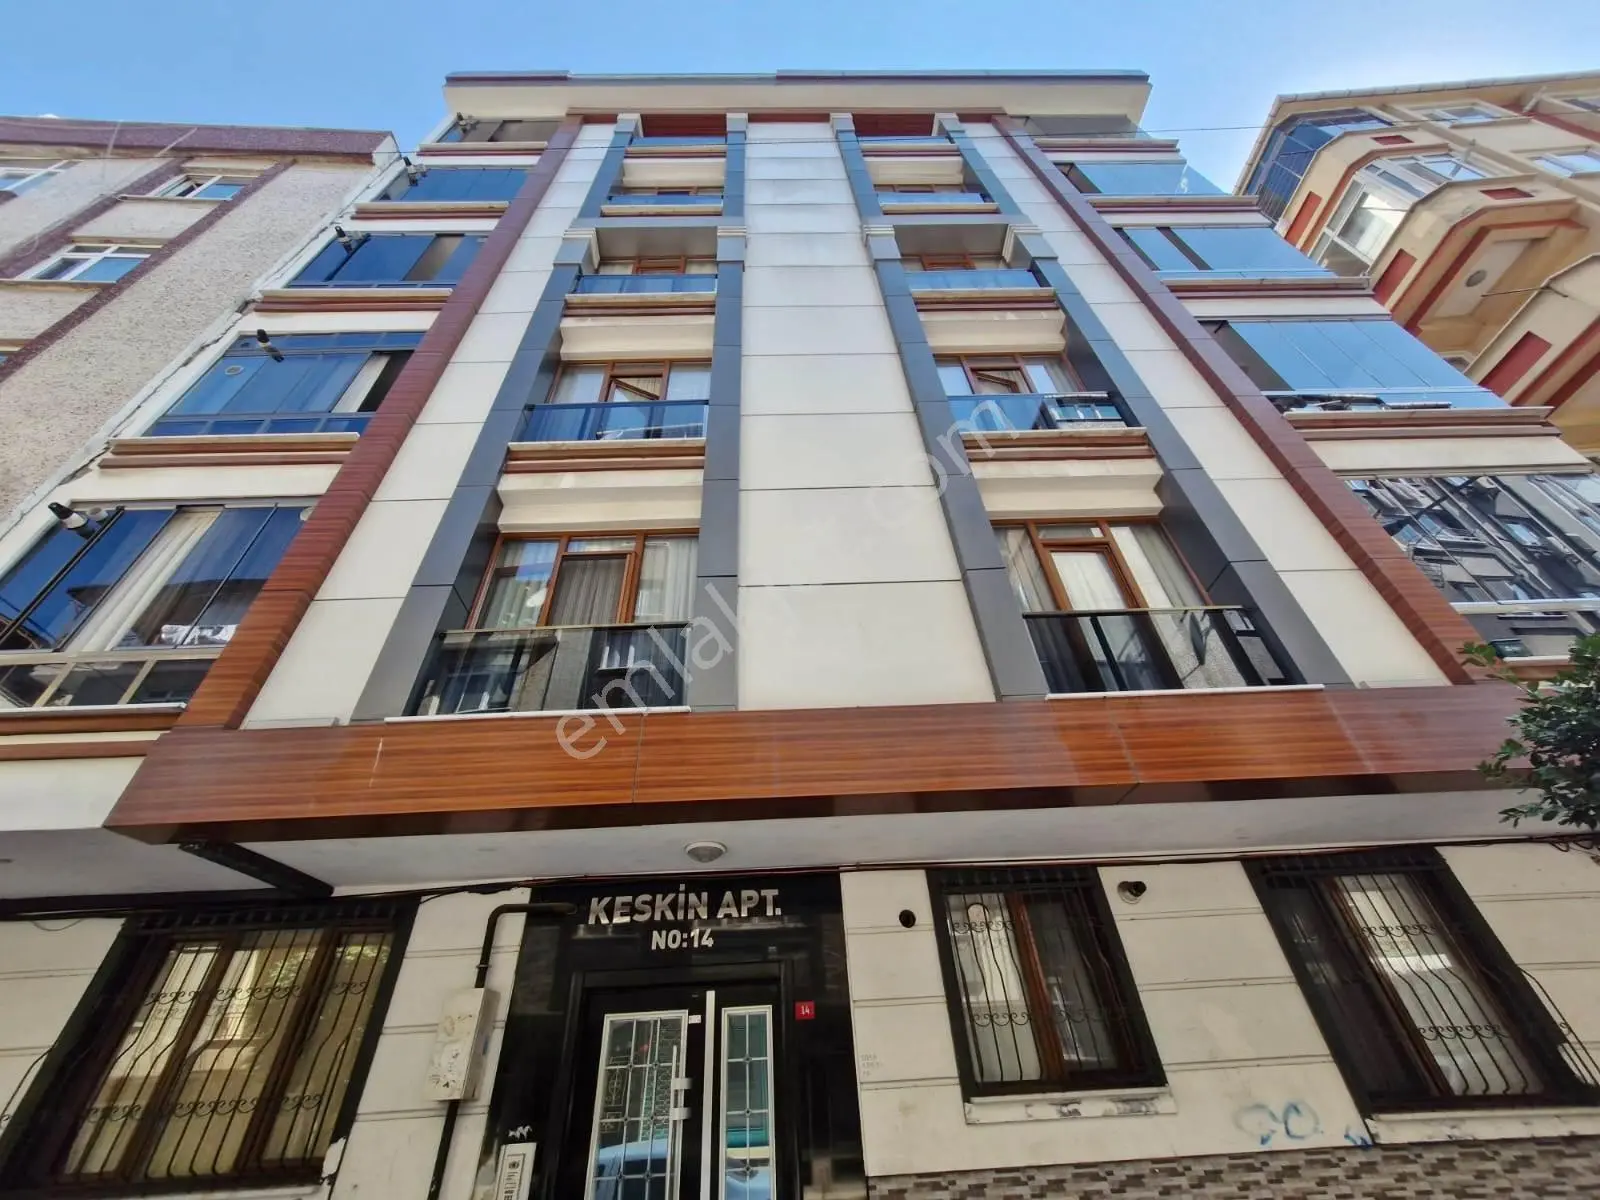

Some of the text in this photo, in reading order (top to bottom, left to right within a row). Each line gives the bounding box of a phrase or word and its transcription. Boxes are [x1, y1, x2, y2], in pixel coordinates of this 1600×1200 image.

[588, 883, 782, 925] KESKİN APT.
[651, 928, 714, 951] NO:14
[800, 1004, 811, 1016] 14
